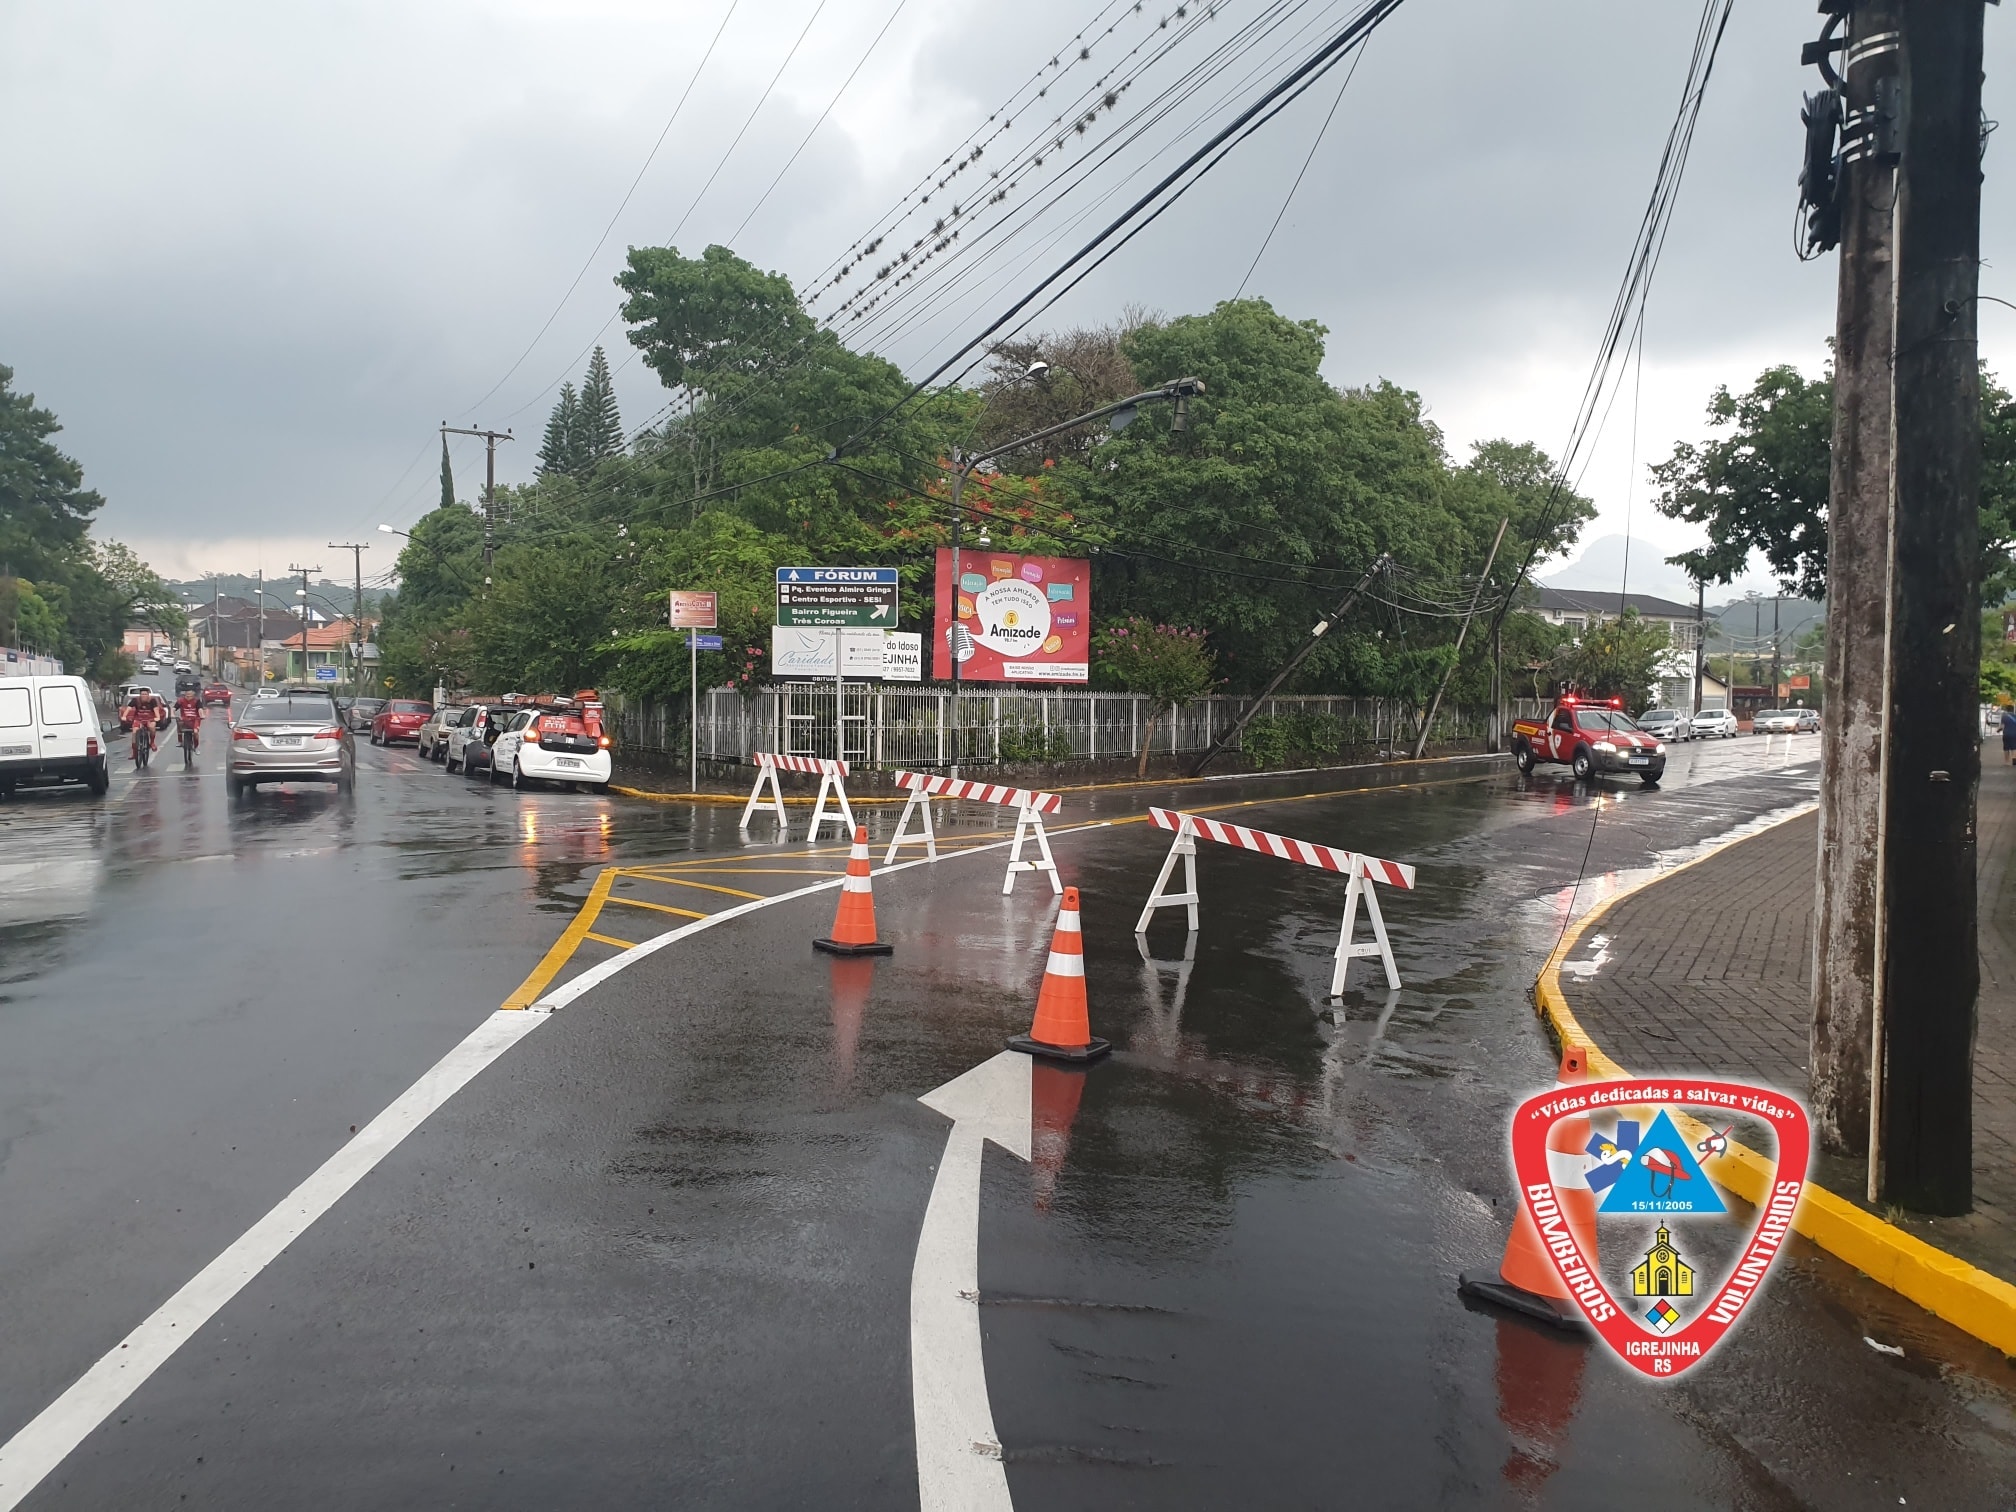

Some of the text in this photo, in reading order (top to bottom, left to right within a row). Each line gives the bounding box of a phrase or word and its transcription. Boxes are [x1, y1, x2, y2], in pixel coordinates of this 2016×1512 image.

[814, 569, 878, 581] FÓRUM
[792, 586, 804, 594] Pq.
[866, 586, 892, 594] Grings
[990, 588, 1012, 597] NOSSA
[1013, 587, 1040, 604] AMIZADE
[820, 596, 857, 604] Esportivo
[991, 597, 1003, 606] TEM
[1020, 597, 1033, 609] ISSO
[821, 608, 858, 617] Figueira
[990, 623, 1041, 639] Amizade
[886, 640, 919, 651] do Idoso
[778, 651, 836, 667] Caridade
